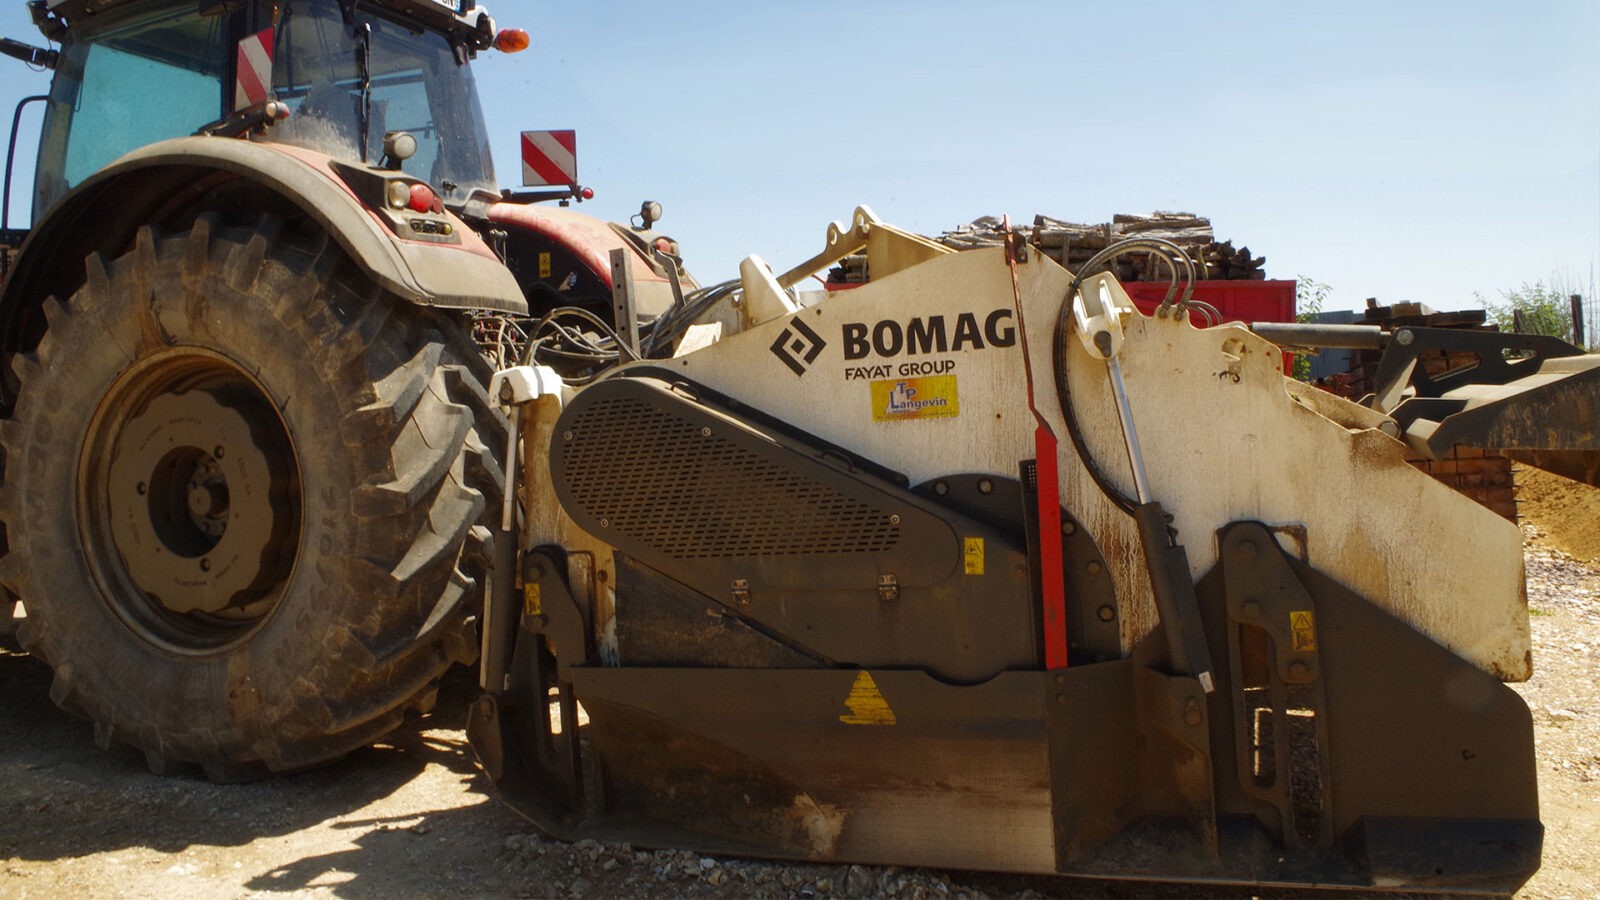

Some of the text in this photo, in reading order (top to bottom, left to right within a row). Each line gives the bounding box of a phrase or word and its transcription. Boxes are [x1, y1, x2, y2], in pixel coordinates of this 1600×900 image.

[842, 309, 1016, 360] BOMAG
[845, 360, 956, 380] FAYAT GROUP
[890, 391, 948, 409] Langevin
